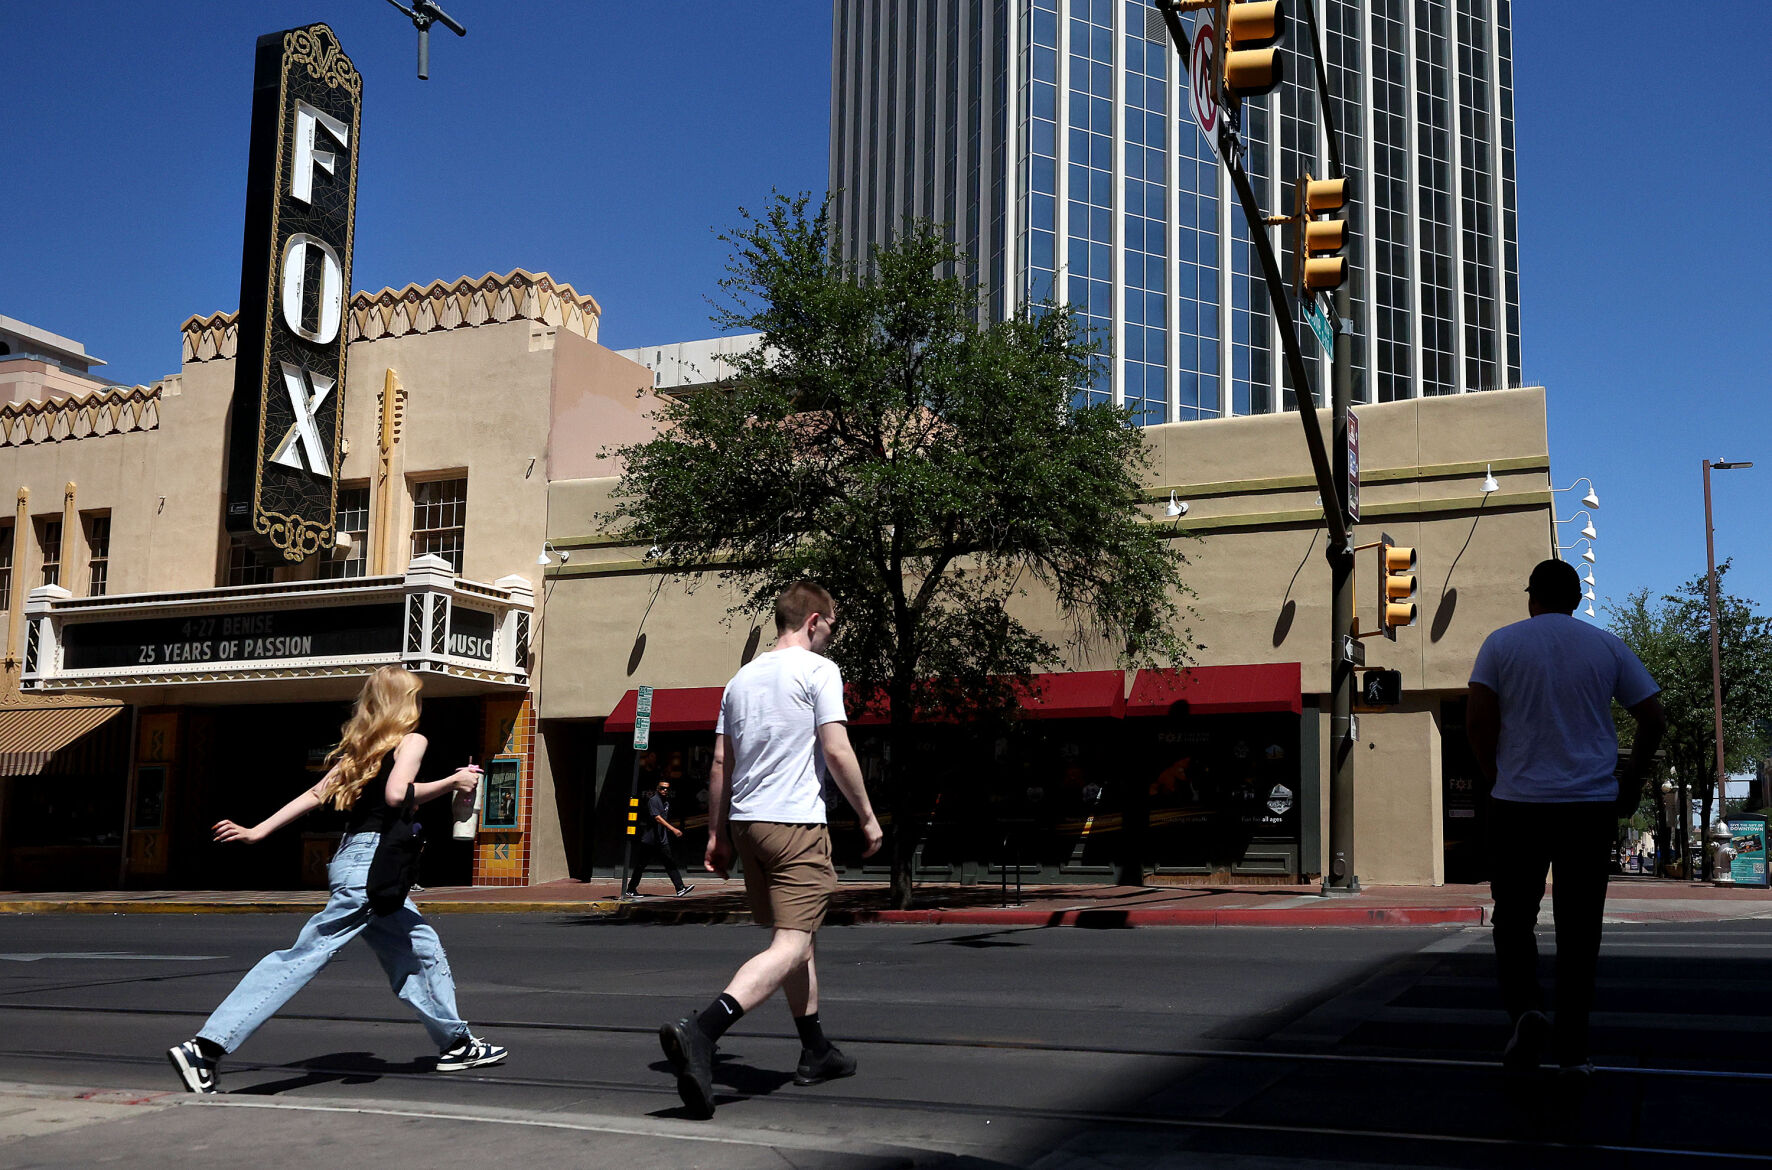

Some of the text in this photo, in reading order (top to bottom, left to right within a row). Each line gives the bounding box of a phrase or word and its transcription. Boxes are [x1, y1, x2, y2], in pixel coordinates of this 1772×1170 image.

[268, 98, 348, 478] FOX
[181, 614, 274, 638] 4-27 BENISE
[138, 635, 312, 663] 25 YEARS OF PASSION
[448, 634, 492, 659] MUSIC
